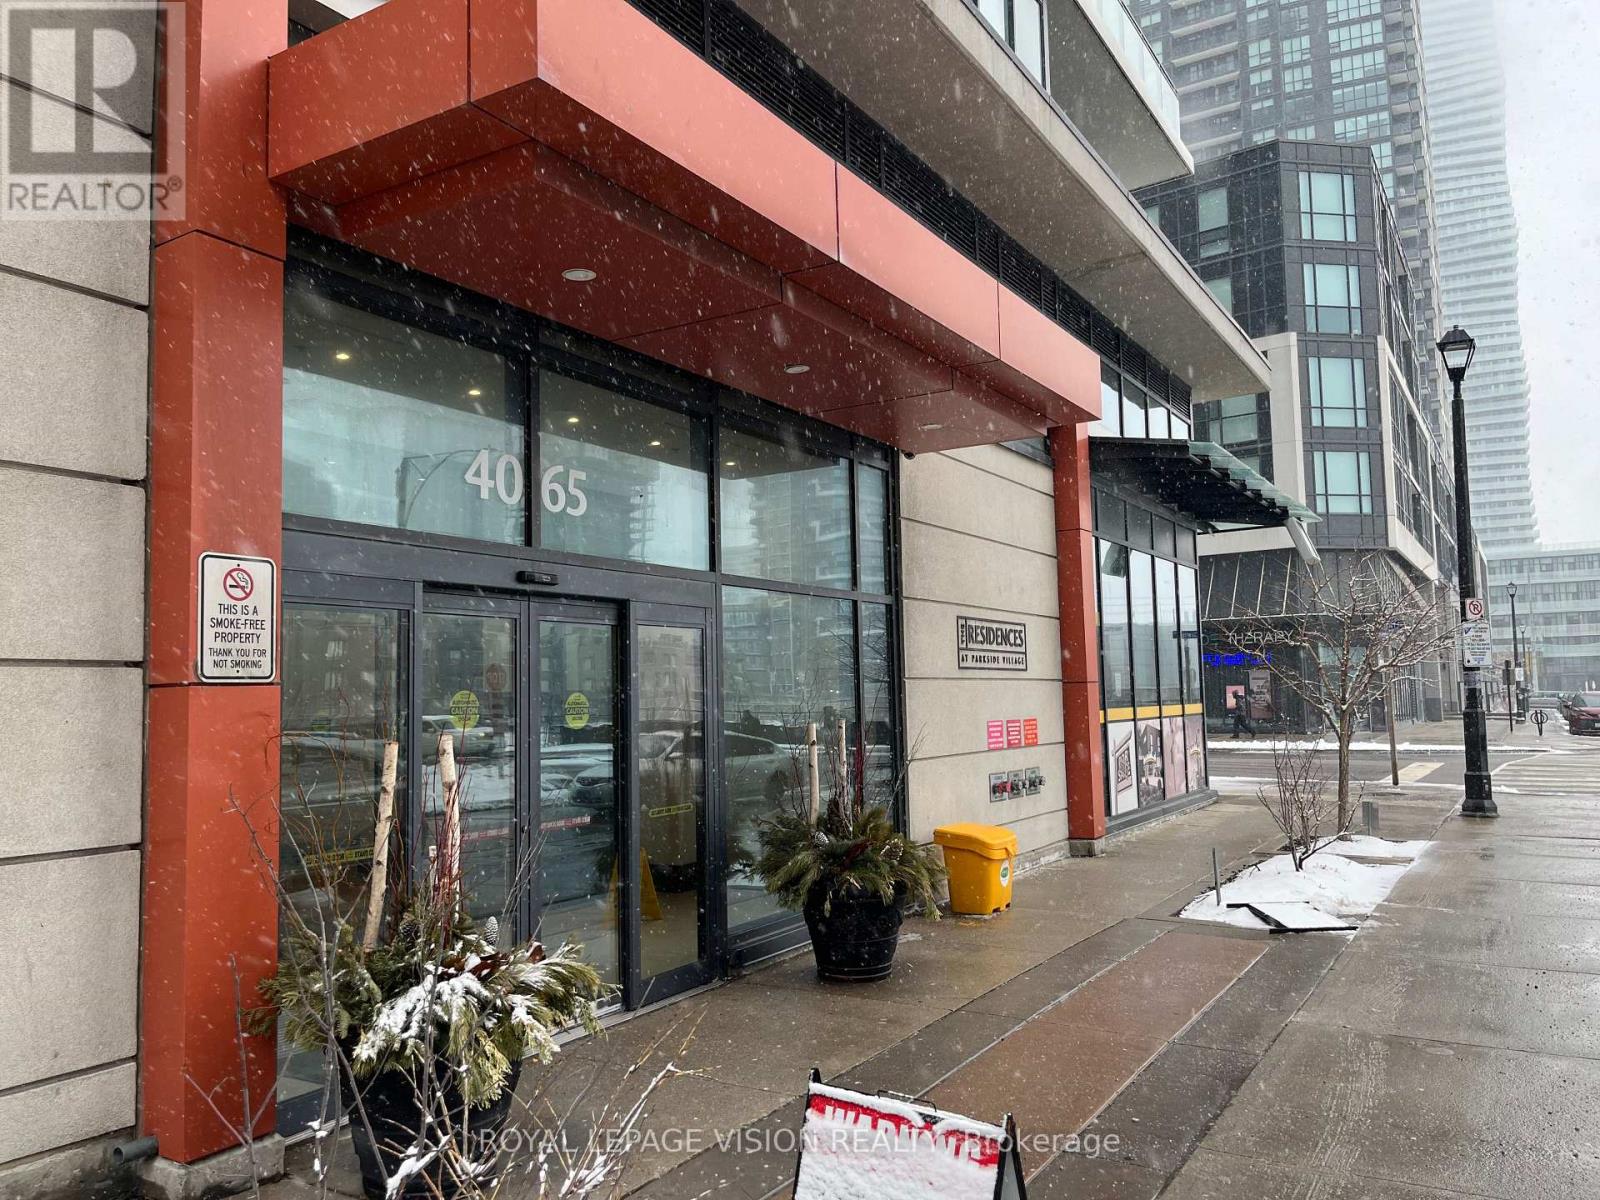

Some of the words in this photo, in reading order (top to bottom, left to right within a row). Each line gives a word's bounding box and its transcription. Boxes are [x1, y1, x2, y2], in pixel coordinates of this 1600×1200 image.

[218, 603, 238, 615] THIS
[241, 605, 249, 616] IS
[252, 605, 259, 616] A
[210, 617, 266, 630] SMOKE-FREE
[214, 631, 261, 644] PROPERTY
[967, 624, 1024, 648] RESIDENCES
[208, 647, 233, 657] THANK
[235, 648, 250, 657] YOU
[253, 649, 267, 658] FOR
[213, 659, 228, 668] NOT
[230, 660, 262, 669] SMOKING
[971, 654, 1000, 665] PARKSIDE
[1002, 656, 1025, 666] VILLAGE
[451, 706, 479, 715] CAUTION
[566, 707, 589, 715] CAUTION
